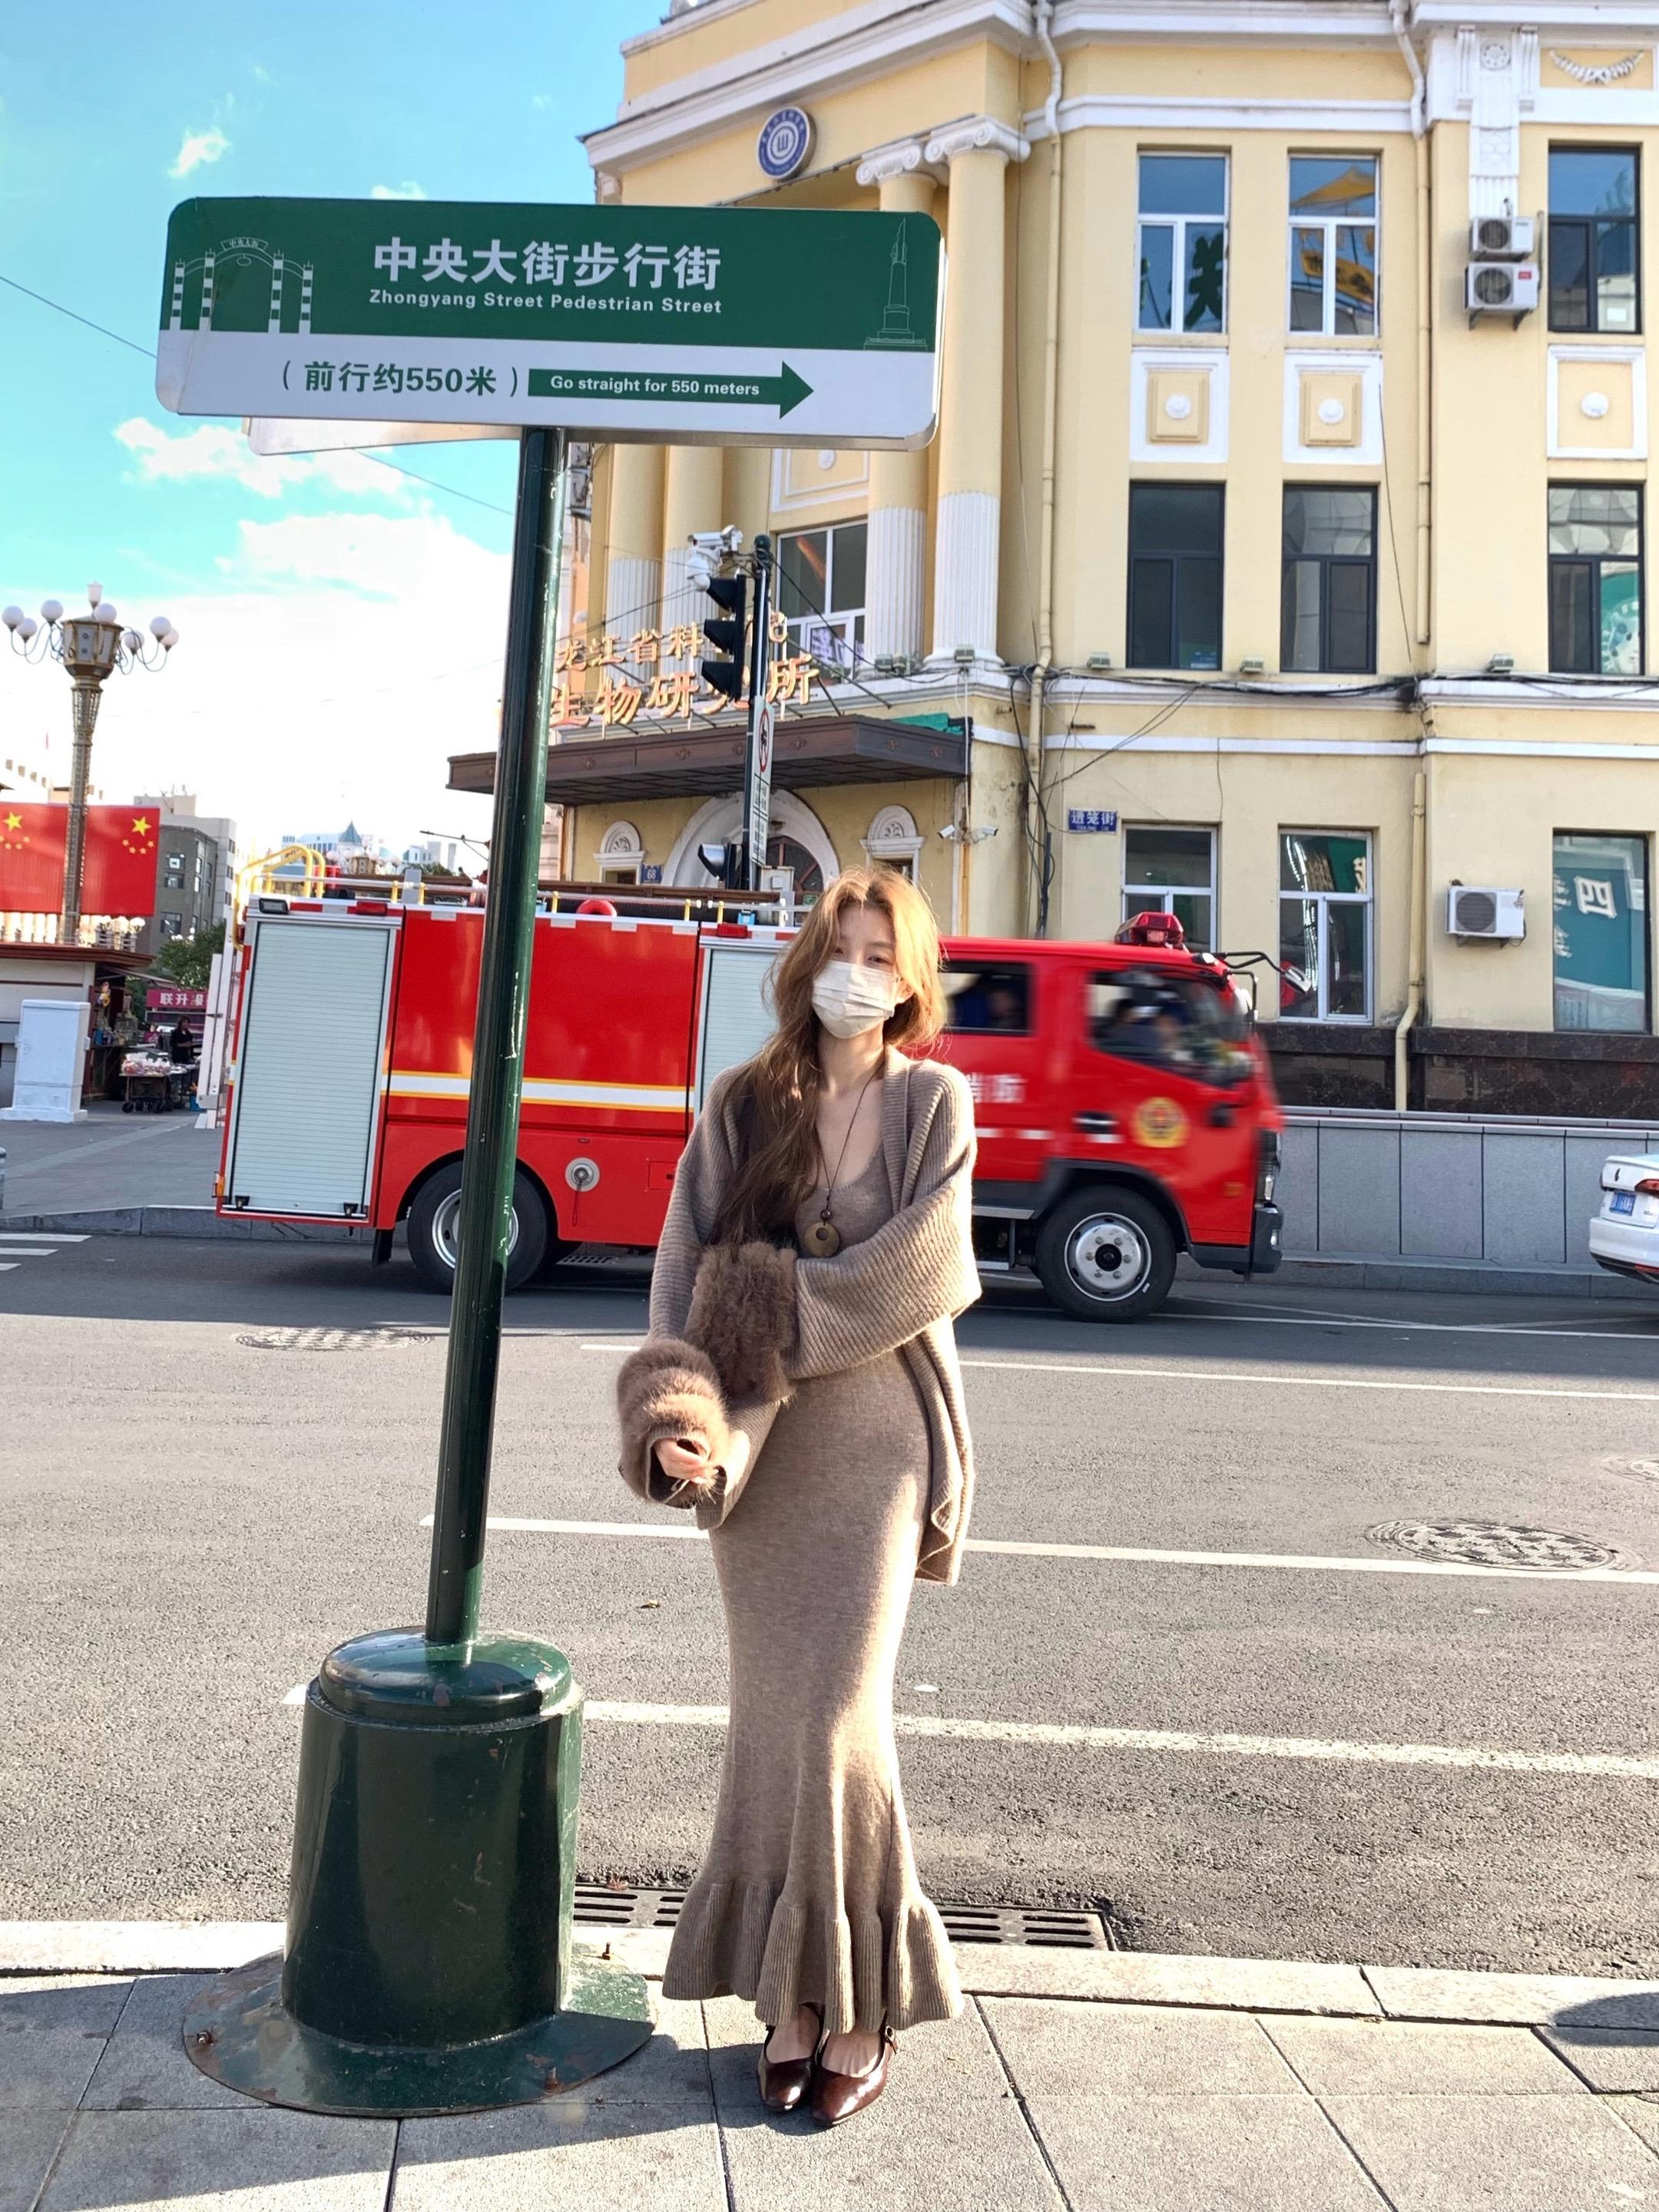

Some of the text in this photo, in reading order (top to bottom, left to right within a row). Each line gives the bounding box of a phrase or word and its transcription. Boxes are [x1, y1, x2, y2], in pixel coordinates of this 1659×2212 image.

[373, 236, 722, 290] 中央大街步行街
[369, 288, 722, 313] Zhongyang Street Pedestrian Street
[550, 375, 760, 396] Go straight for 550 meters
